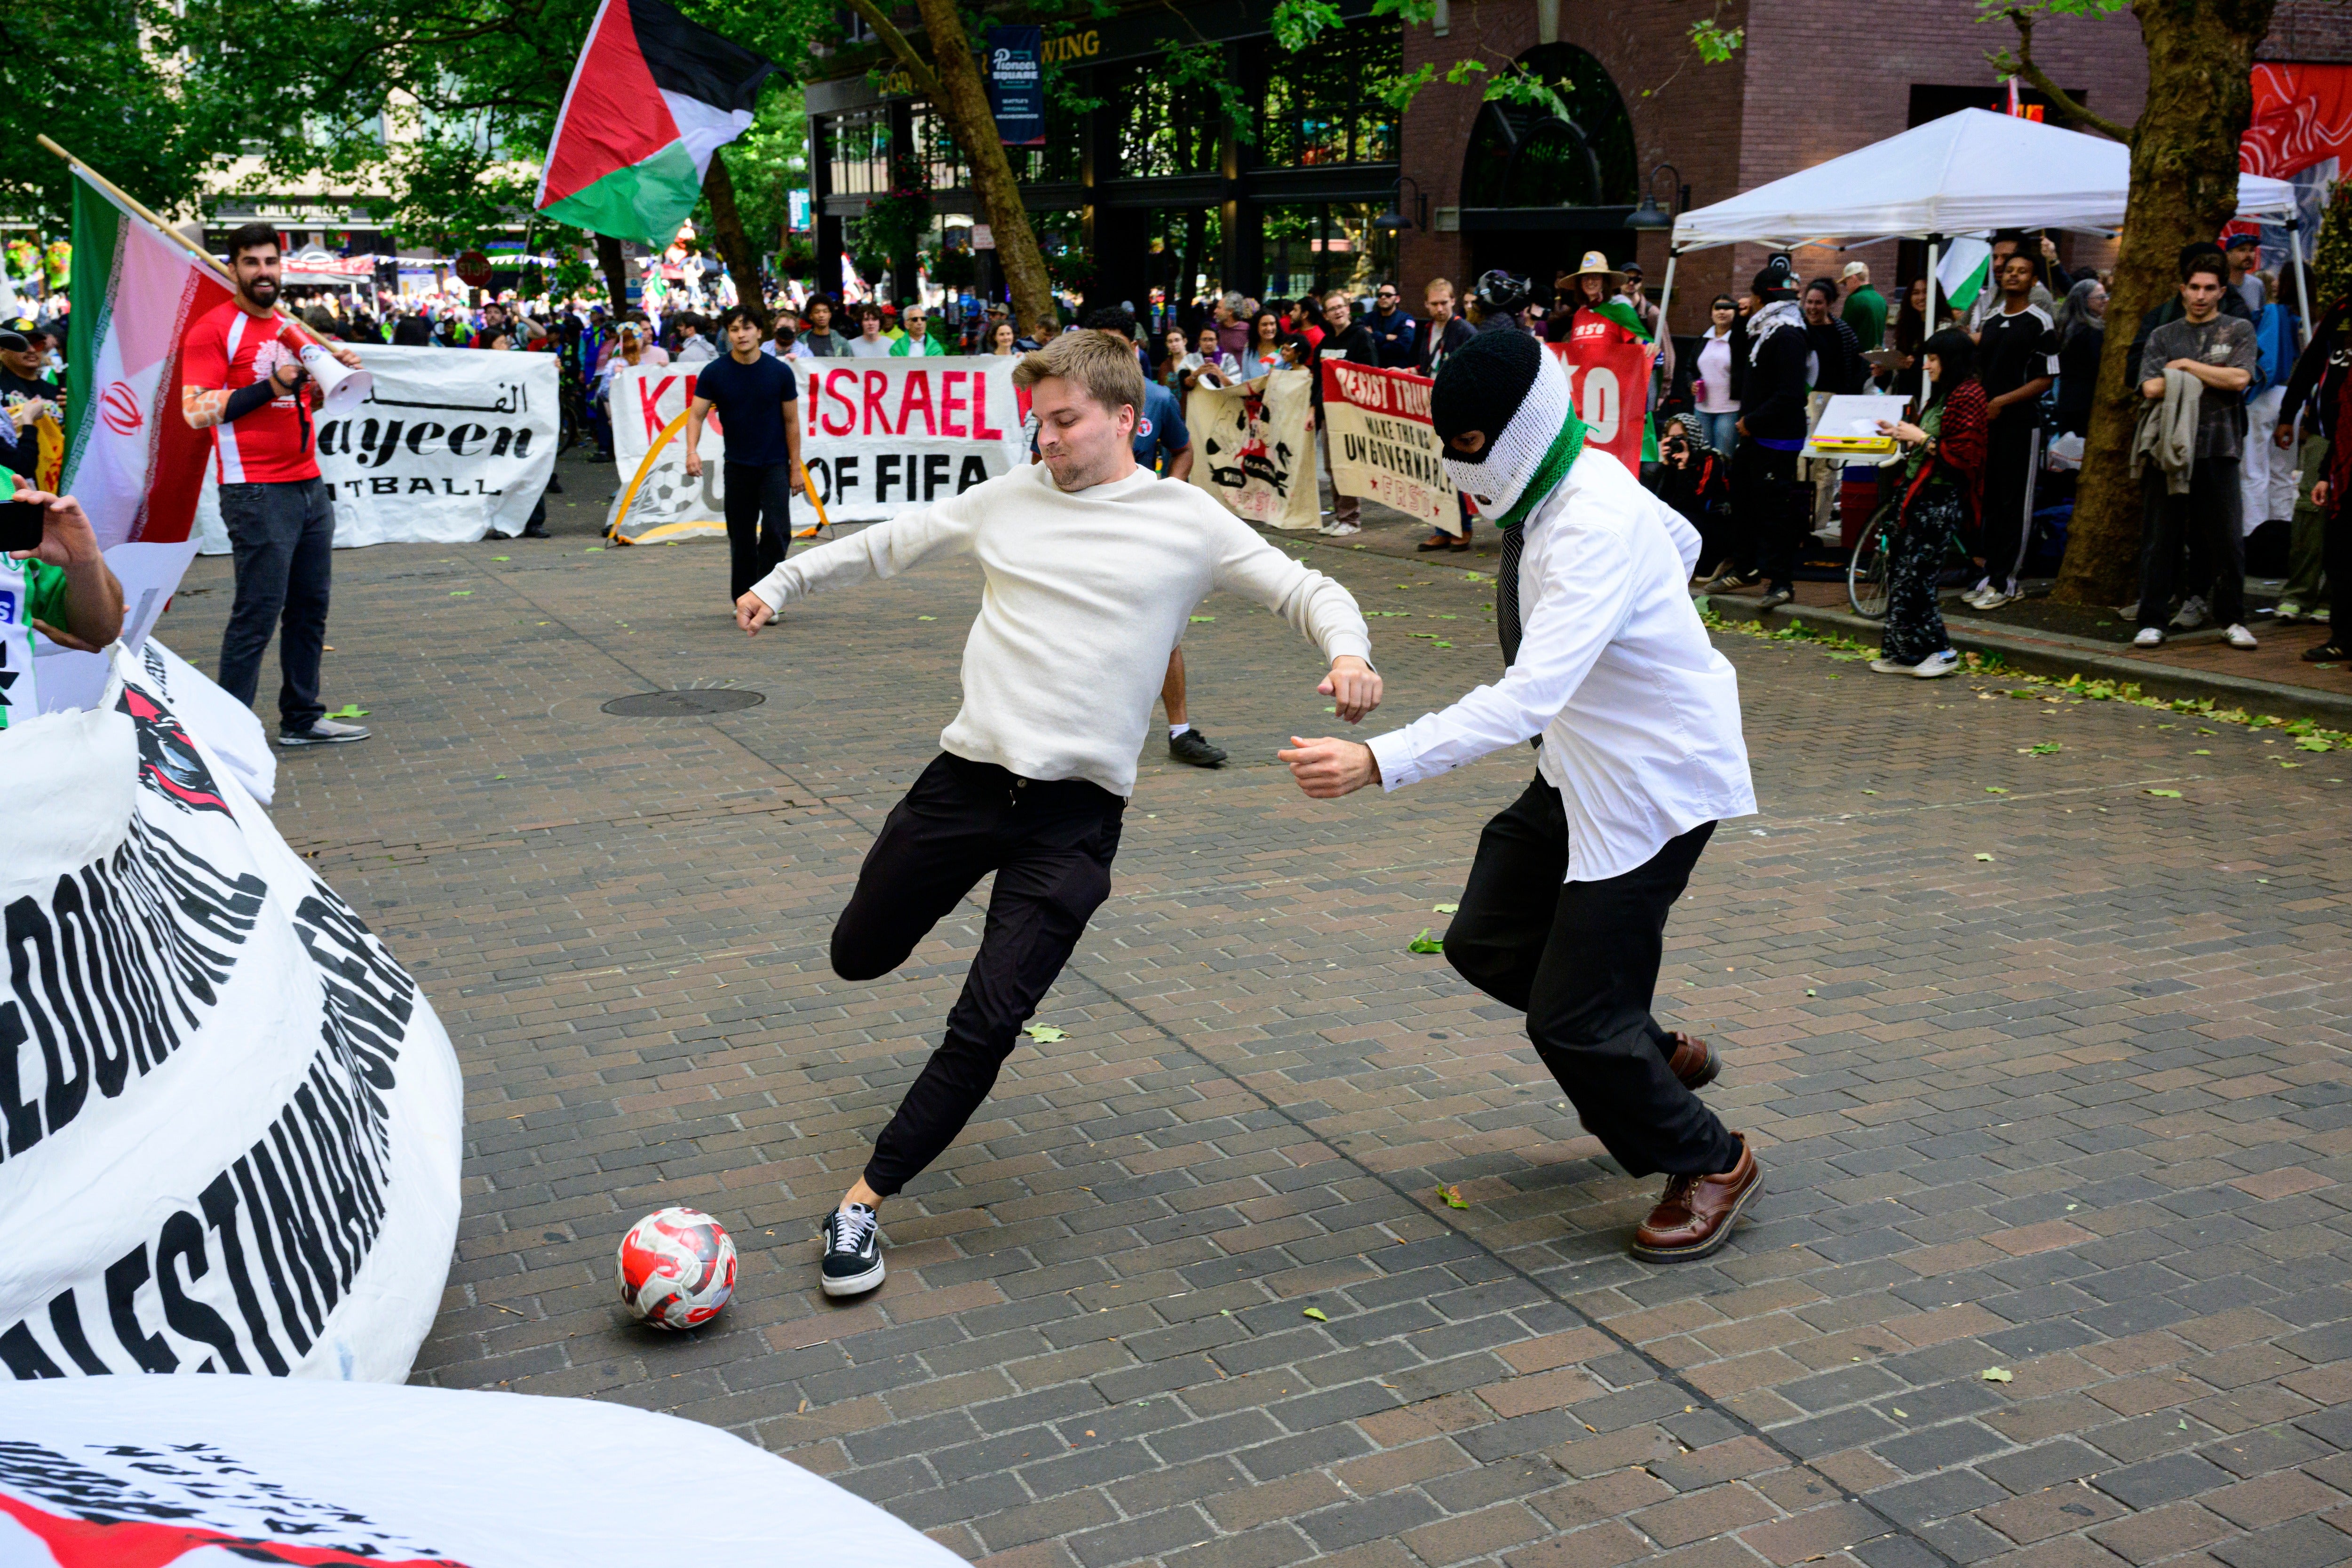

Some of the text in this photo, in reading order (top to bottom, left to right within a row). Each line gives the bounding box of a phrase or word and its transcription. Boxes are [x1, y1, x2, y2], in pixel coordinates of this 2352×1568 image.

[808, 368, 1003, 441] ISRAEL
[1335, 367, 1433, 420] RESIST TRUM
[318, 417, 535, 470] ayeen
[1395, 423, 1414, 445] THE
[803, 454, 988, 506] OF FIFA
